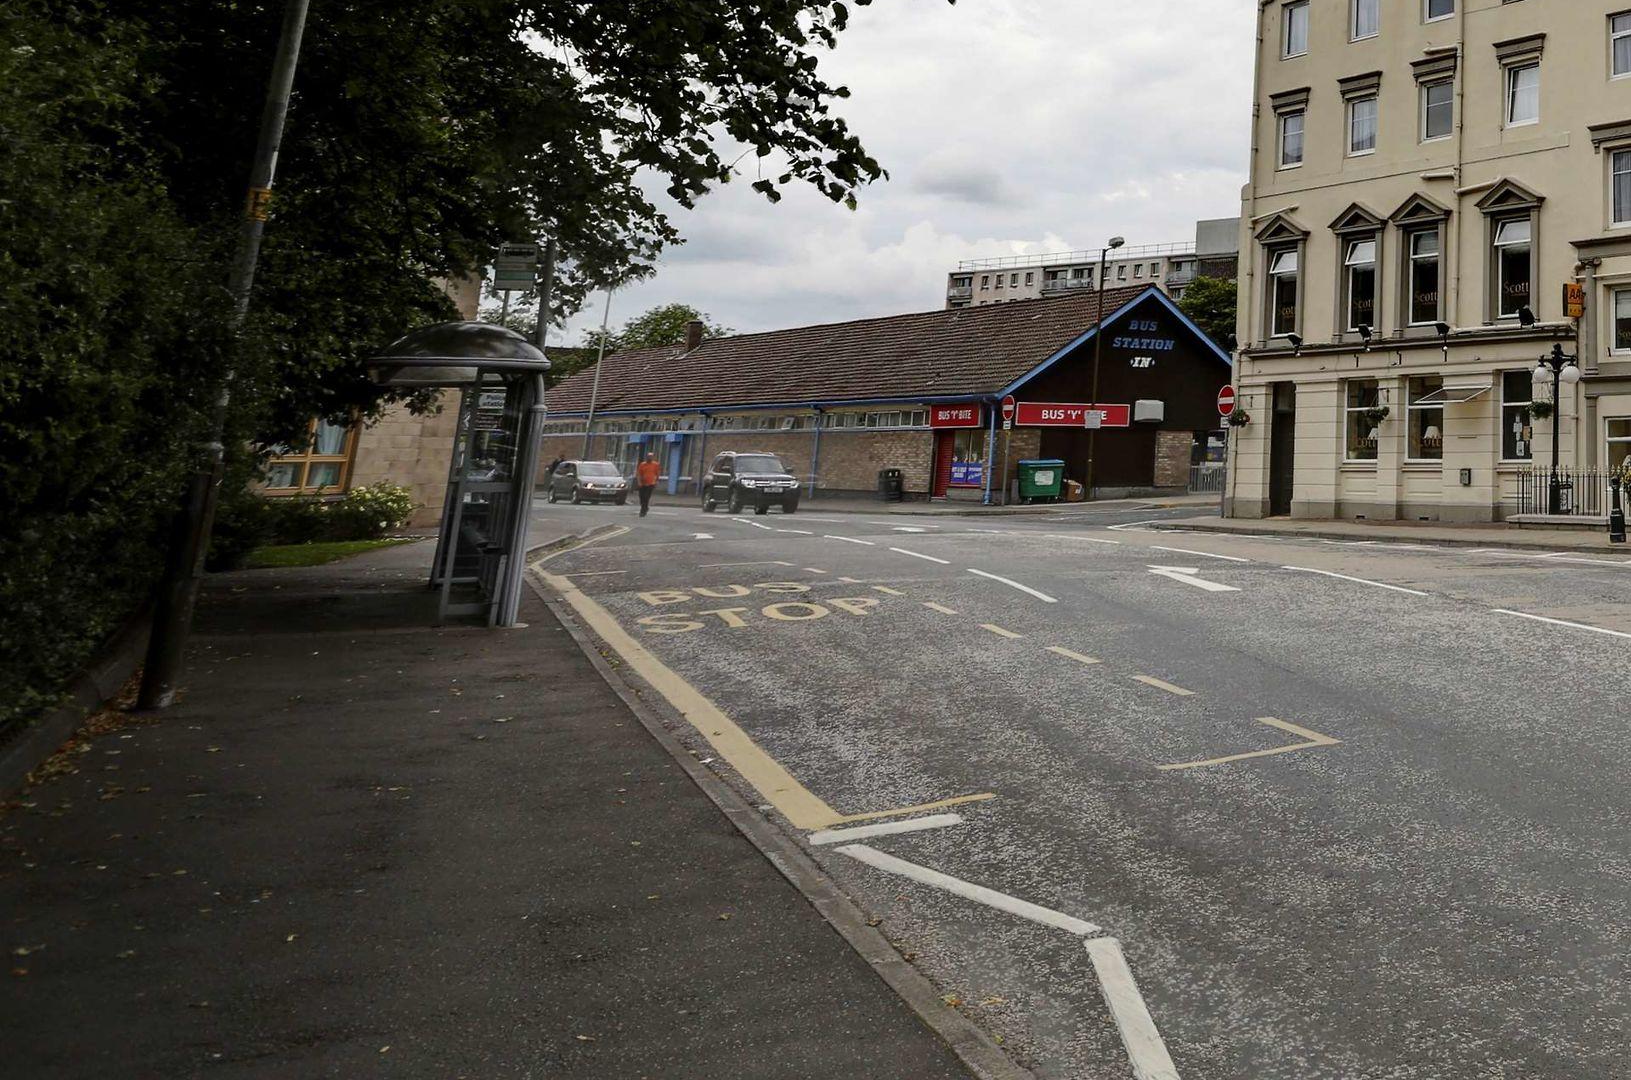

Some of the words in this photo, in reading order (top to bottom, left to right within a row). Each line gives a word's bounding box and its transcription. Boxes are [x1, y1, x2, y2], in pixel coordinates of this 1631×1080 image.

[1569, 288, 1581, 300] AA
[1128, 320, 1158, 332] BUS
[1112, 337, 1175, 350] STATION
[938, 410, 950, 420] BUS
[1041, 409, 1065, 420] BUS
[1067, 409, 1081, 420] 'Y'
[636, 581, 811, 606] BUS
[636, 597, 880, 633] STOP
